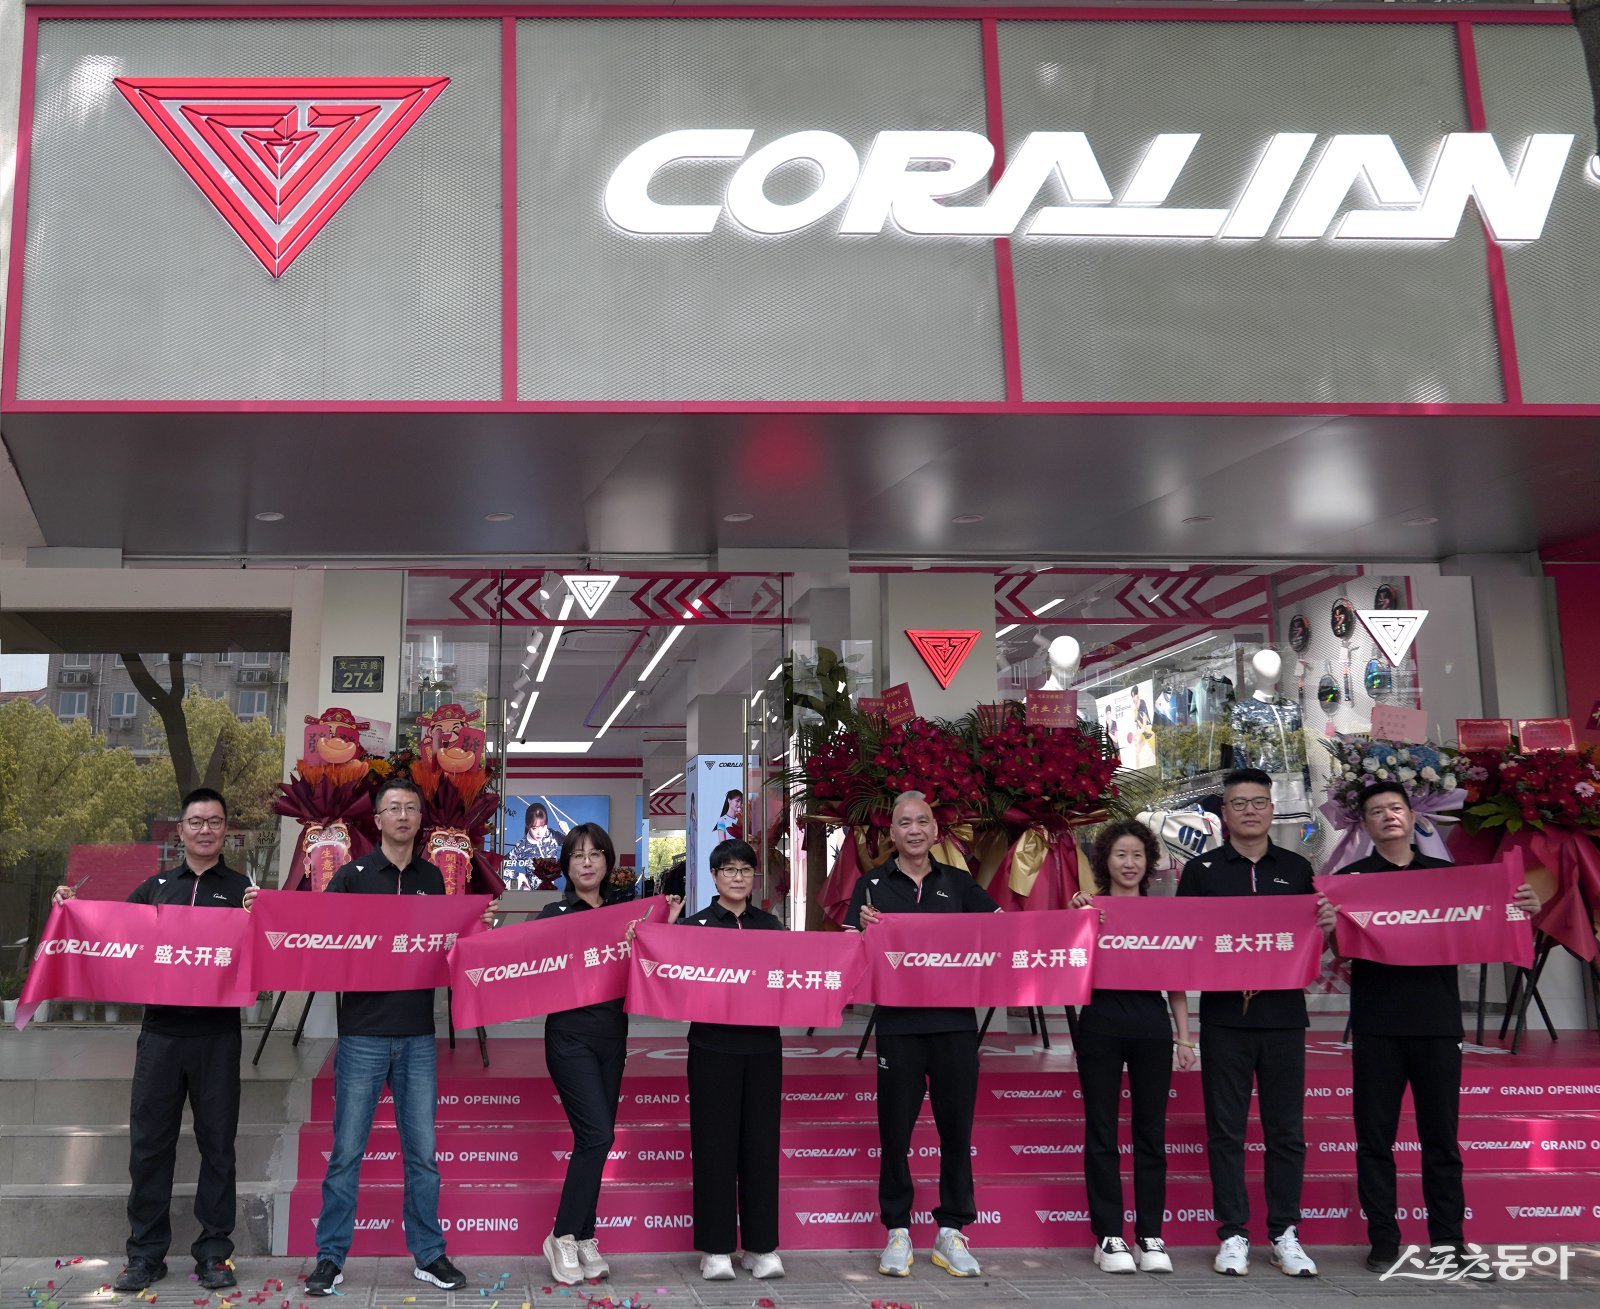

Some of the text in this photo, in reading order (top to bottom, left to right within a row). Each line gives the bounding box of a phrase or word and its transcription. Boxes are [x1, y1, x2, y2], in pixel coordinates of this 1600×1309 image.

[603, 129, 1575, 243] CORALIAN
[342, 672, 374, 688] 274
[1031, 703, 1072, 714] 开业大吉
[1372, 905, 1484, 925] CORALIAN
[284, 934, 378, 949] CORALIAN
[1098, 932, 1294, 953] CORALIAN 盛大开幕
[45, 939, 232, 967] CORALIAN 盛大开幕
[903, 948, 1088, 968] CORALIAN 盛大开幕
[483, 941, 631, 982] CORALIAN 盛大开
[657, 964, 841, 990] CORALIAN 盛大开幕
[1004, 1090, 1062, 1098] CORALIAN
[1305, 1088, 1332, 1096] AND
[1500, 1086, 1543, 1095] GRAND
[1548, 1085, 1600, 1094] OPENING
[464, 1096, 520, 1104] OPENING
[635, 1095, 680, 1103] GRAND
[855, 1092, 878, 1101] GRA
[1023, 1144, 1203, 1153] CORALIAN ENING
[1319, 1142, 1358, 1151] GRAN
[1471, 1141, 1530, 1149] CORALIAN
[1541, 1140, 1586, 1150] GRAND
[459, 1152, 518, 1161] OPENING
[638, 1151, 684, 1160] GRAND
[795, 1148, 856, 1157] CORALIAN
[1049, 1210, 1091, 1221] CORAL
[1177, 1209, 1217, 1222] OPEN
[1300, 1208, 1348, 1218] RALIAN
[1519, 1206, 1581, 1217] CORALIAN
[644, 1215, 693, 1228] GRAND
[809, 1212, 874, 1223] CORALIAN
[457, 1218, 518, 1231] OPENING
